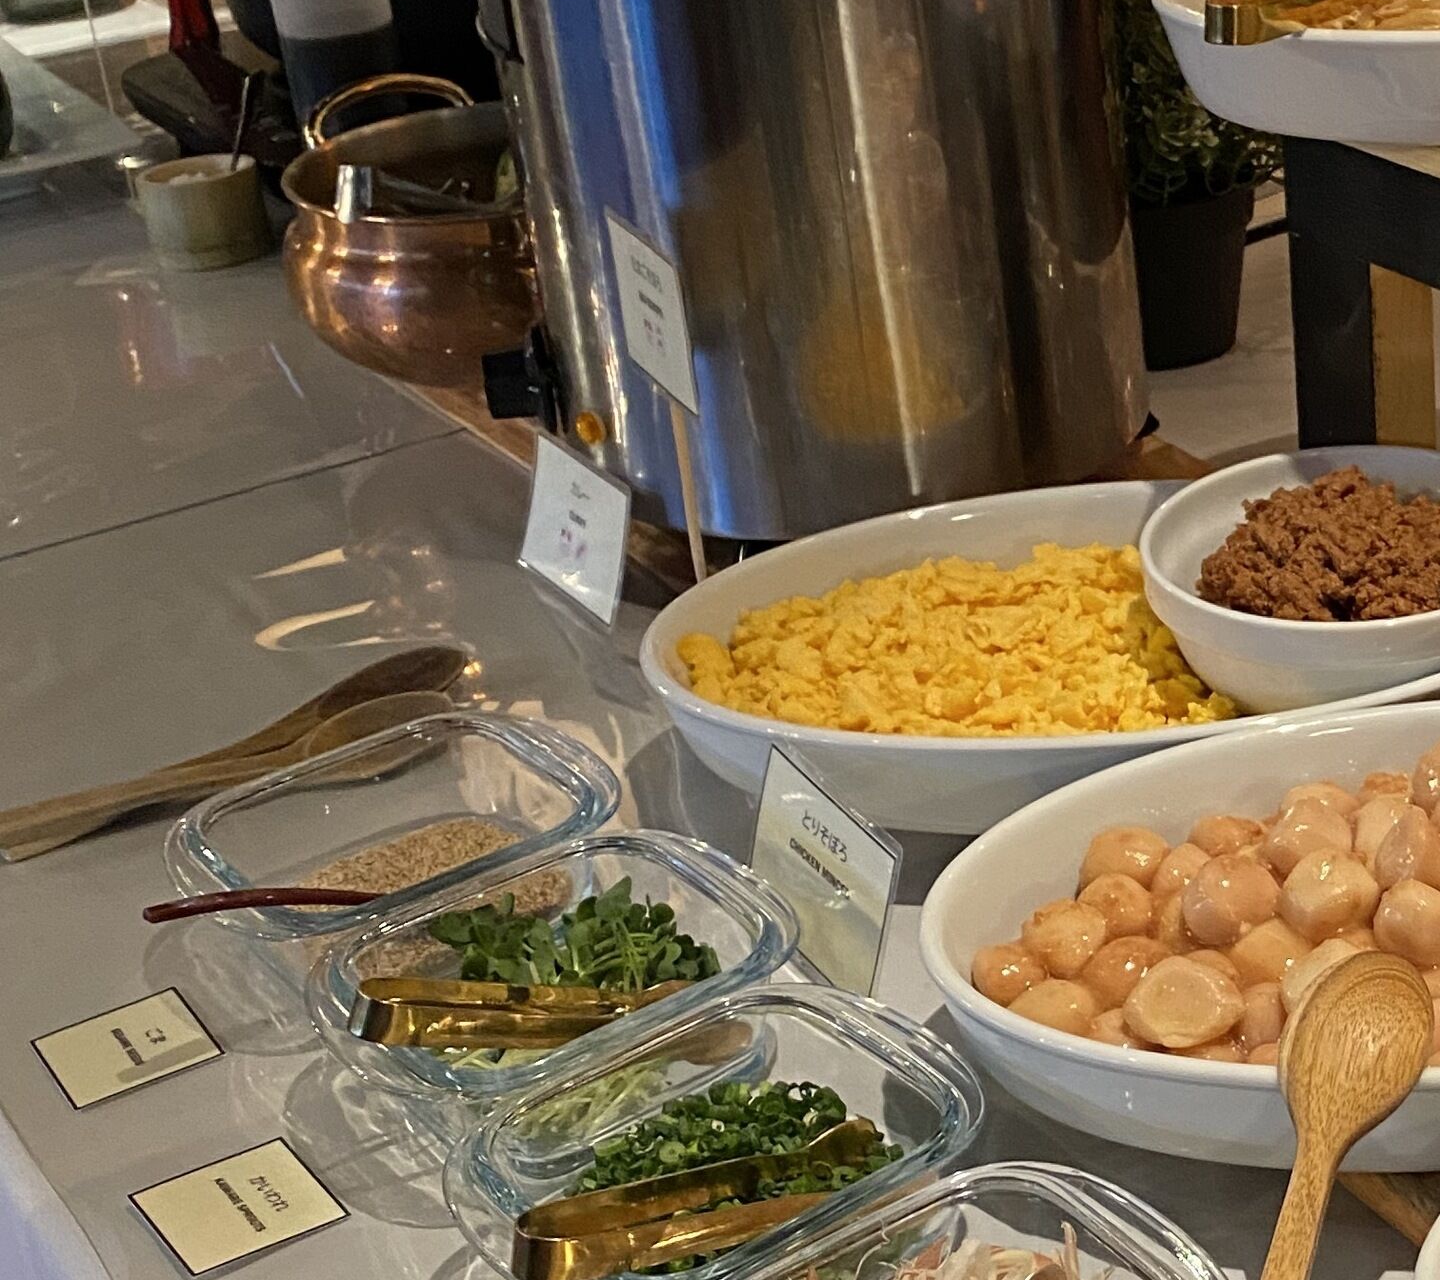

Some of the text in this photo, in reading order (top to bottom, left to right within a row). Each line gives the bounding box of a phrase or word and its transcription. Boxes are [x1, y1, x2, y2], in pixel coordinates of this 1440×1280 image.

[789, 837, 822, 872] CHICKEN
[801, 808, 848, 863] とりそぼろ
